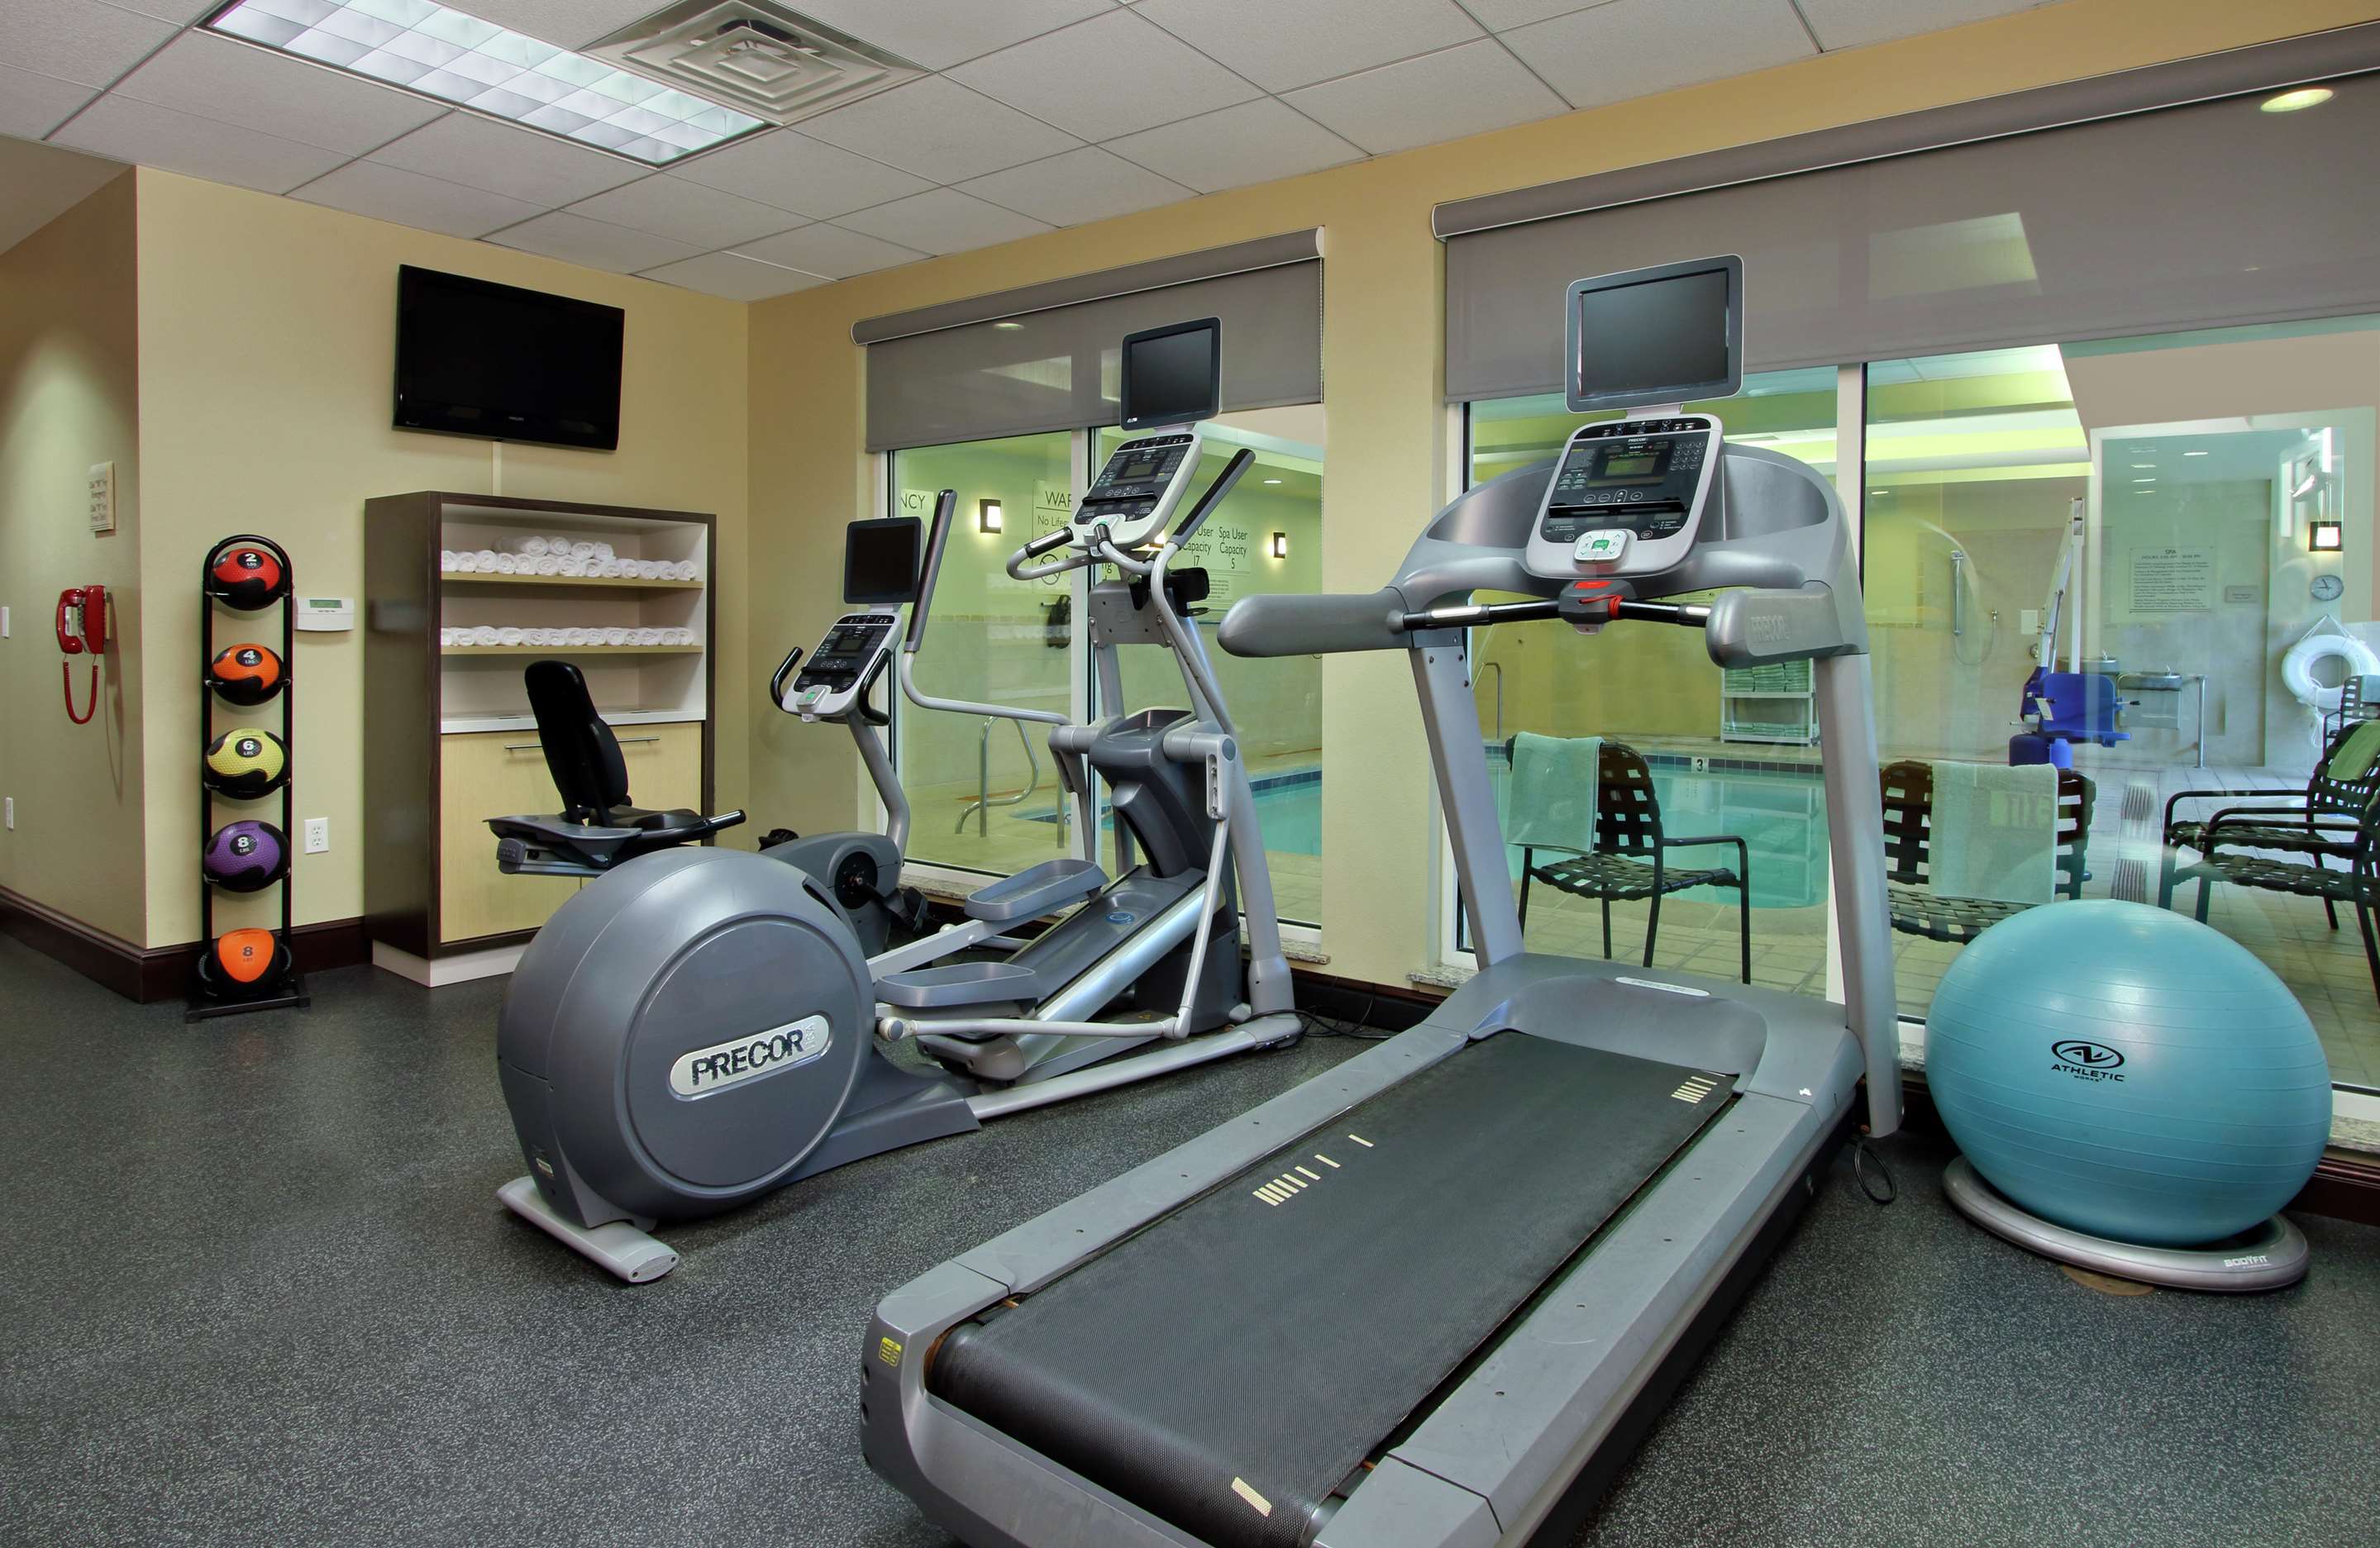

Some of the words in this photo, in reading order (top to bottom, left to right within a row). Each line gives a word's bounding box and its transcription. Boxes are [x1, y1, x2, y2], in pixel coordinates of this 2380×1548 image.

[1037, 515, 1049, 526] No
[1197, 525, 1214, 537] User
[1219, 526, 1230, 541] Spa
[1232, 528, 1247, 540] User
[1219, 542, 1247, 559] Capacity
[245, 553, 257, 562] 2
[243, 650, 255, 660] 4
[243, 741, 255, 750] 6
[1696, 759, 1704, 772] 3
[237, 836, 250, 848] 8
[243, 946, 253, 956] 8
[691, 1029, 804, 1086] PRECOR
[2051, 1064, 2125, 1082] ATHLETIC
[2223, 1255, 2268, 1267] BODYFIT
